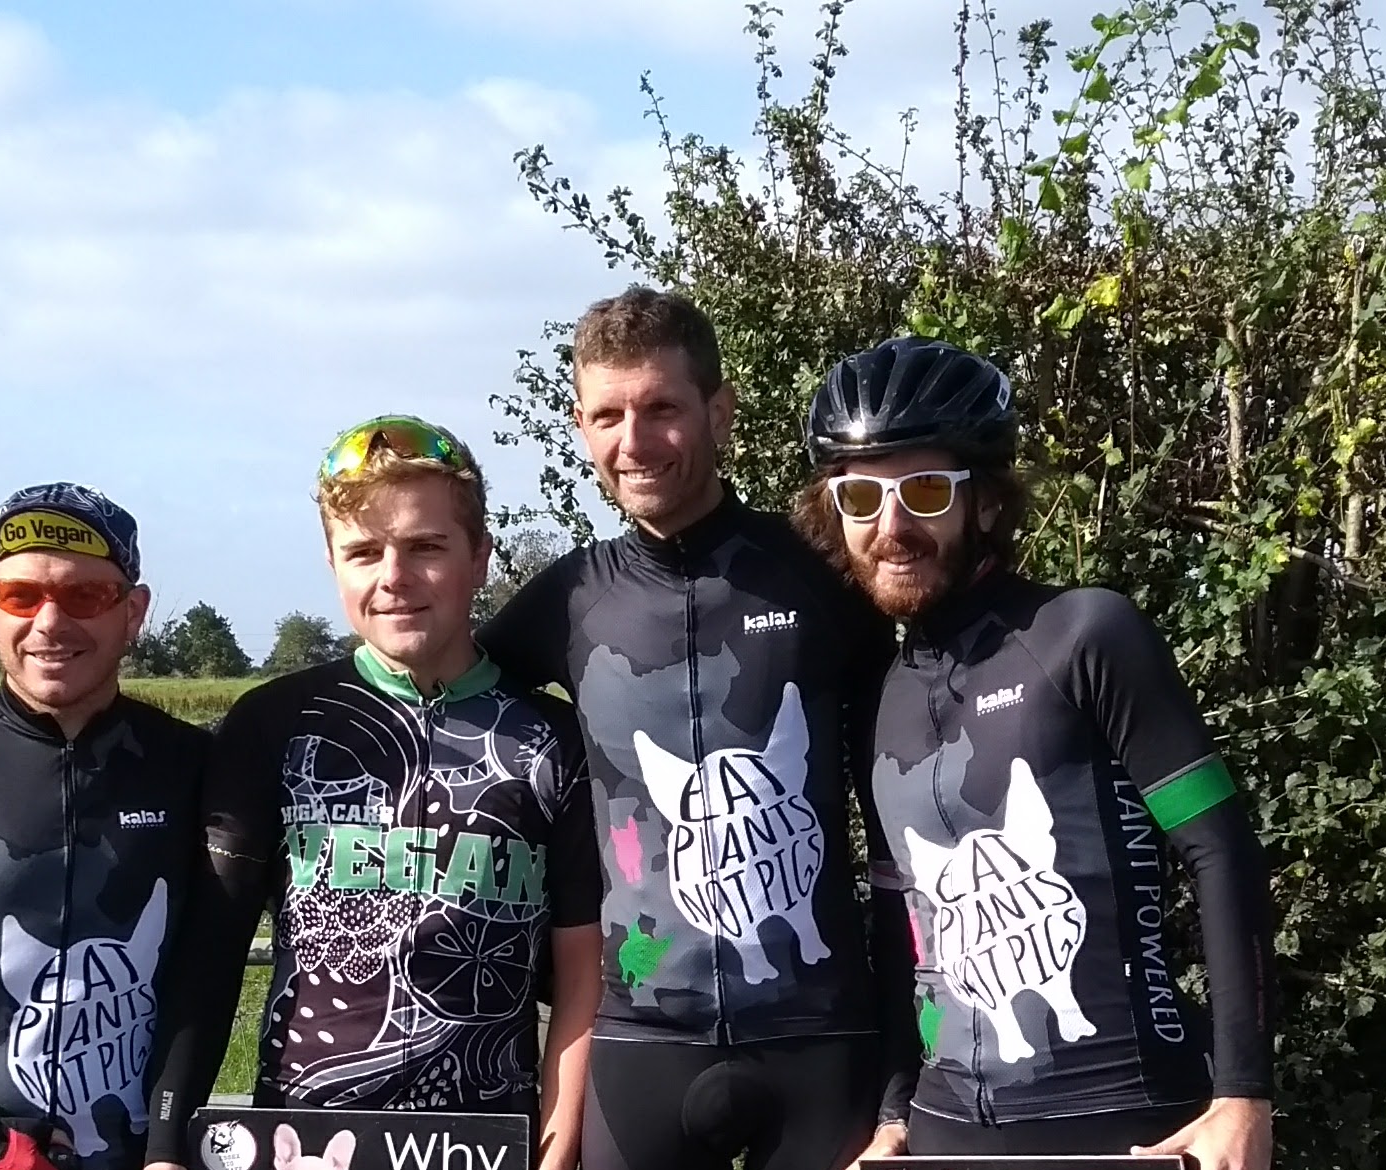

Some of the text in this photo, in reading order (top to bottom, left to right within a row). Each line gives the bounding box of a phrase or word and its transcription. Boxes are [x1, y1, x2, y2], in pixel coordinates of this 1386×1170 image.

[4, 519, 92, 545] Go Vegan
[744, 610, 797, 631] kalas
[119, 810, 165, 825] kalas
[281, 804, 394, 824] HIGH CARB
[680, 754, 787, 823] EAT
[1111, 758, 1161, 872] LANT
[285, 823, 547, 905] VEGAN
[673, 795, 816, 882] PLANTS
[935, 833, 1031, 902] EAT
[678, 834, 822, 938] NOT PIGS
[939, 870, 1072, 961] PLANTS
[31, 943, 139, 1004] EAT
[1017, 907, 1082, 986] PIGS
[1134, 884, 1186, 1043] POWERED
[13, 984, 156, 1057] PLANTS
[15, 1019, 156, 1115] NOT PIGS
